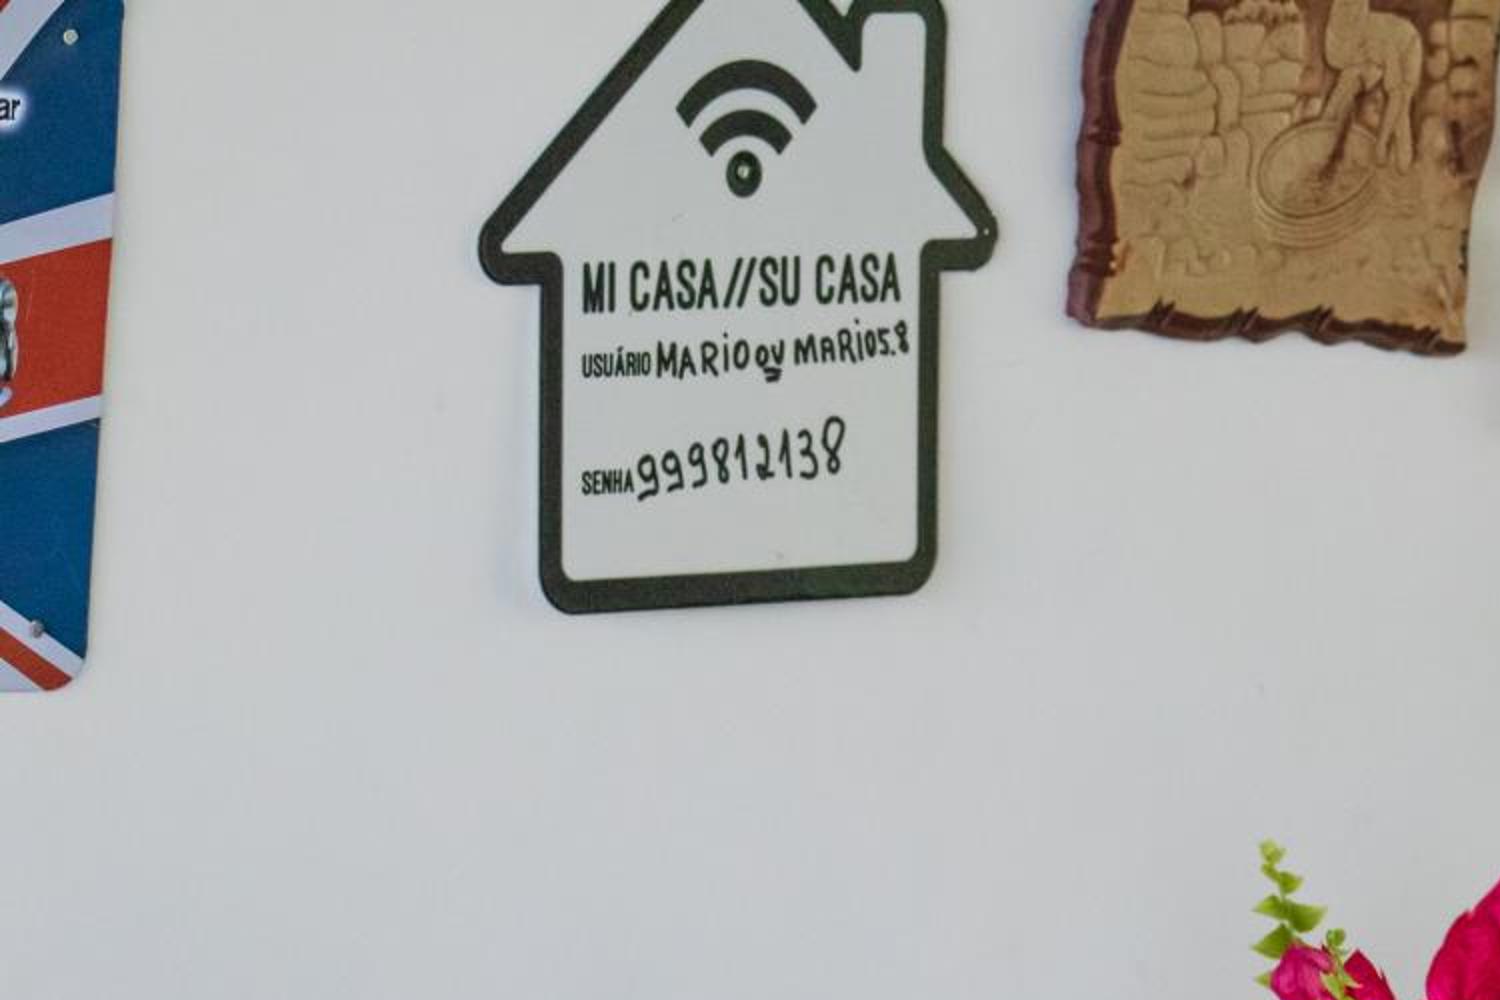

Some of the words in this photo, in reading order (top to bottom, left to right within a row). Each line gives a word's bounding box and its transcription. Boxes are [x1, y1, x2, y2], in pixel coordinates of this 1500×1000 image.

[583, 261, 616, 314] MI
[815, 252, 901, 305] CASA
[581, 346, 651, 378] USUÁRIO
[581, 468, 635, 495] SENHA
[637, 415, 846, 501] 999812138
